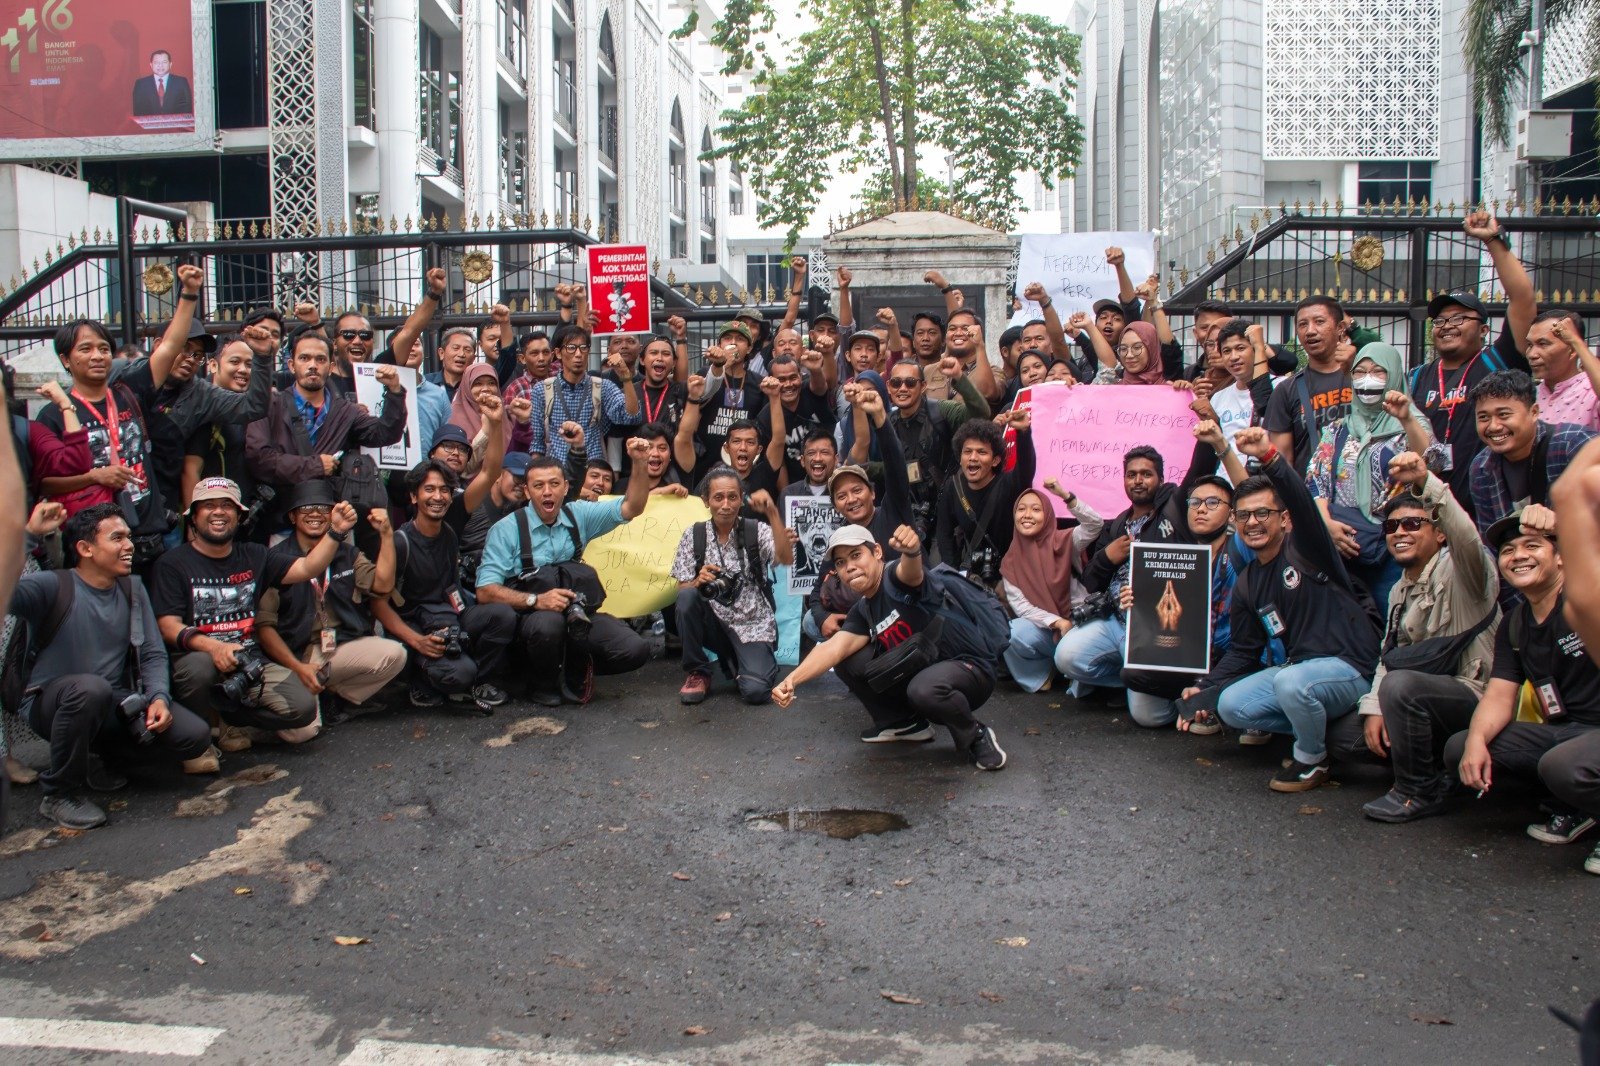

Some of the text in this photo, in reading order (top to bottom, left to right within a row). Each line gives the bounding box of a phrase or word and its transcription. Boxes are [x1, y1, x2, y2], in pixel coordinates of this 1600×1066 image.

[44, 41, 76, 49] BANGKIT
[598, 253, 646, 263] PEMERINTAH
[602, 263, 646, 273] KOK TAKUT
[592, 273, 647, 284] DIINVESTIGASI
[1061, 277, 1093, 299] PERS
[1055, 407, 1101, 426] PASAL
[1143, 551, 1197, 561] RUU PENYIARAN
[1145, 561, 1196, 570] KRIMINALISASI
[1153, 571, 1187, 580] JURNALIS
[212, 622, 238, 632] MEDAN
